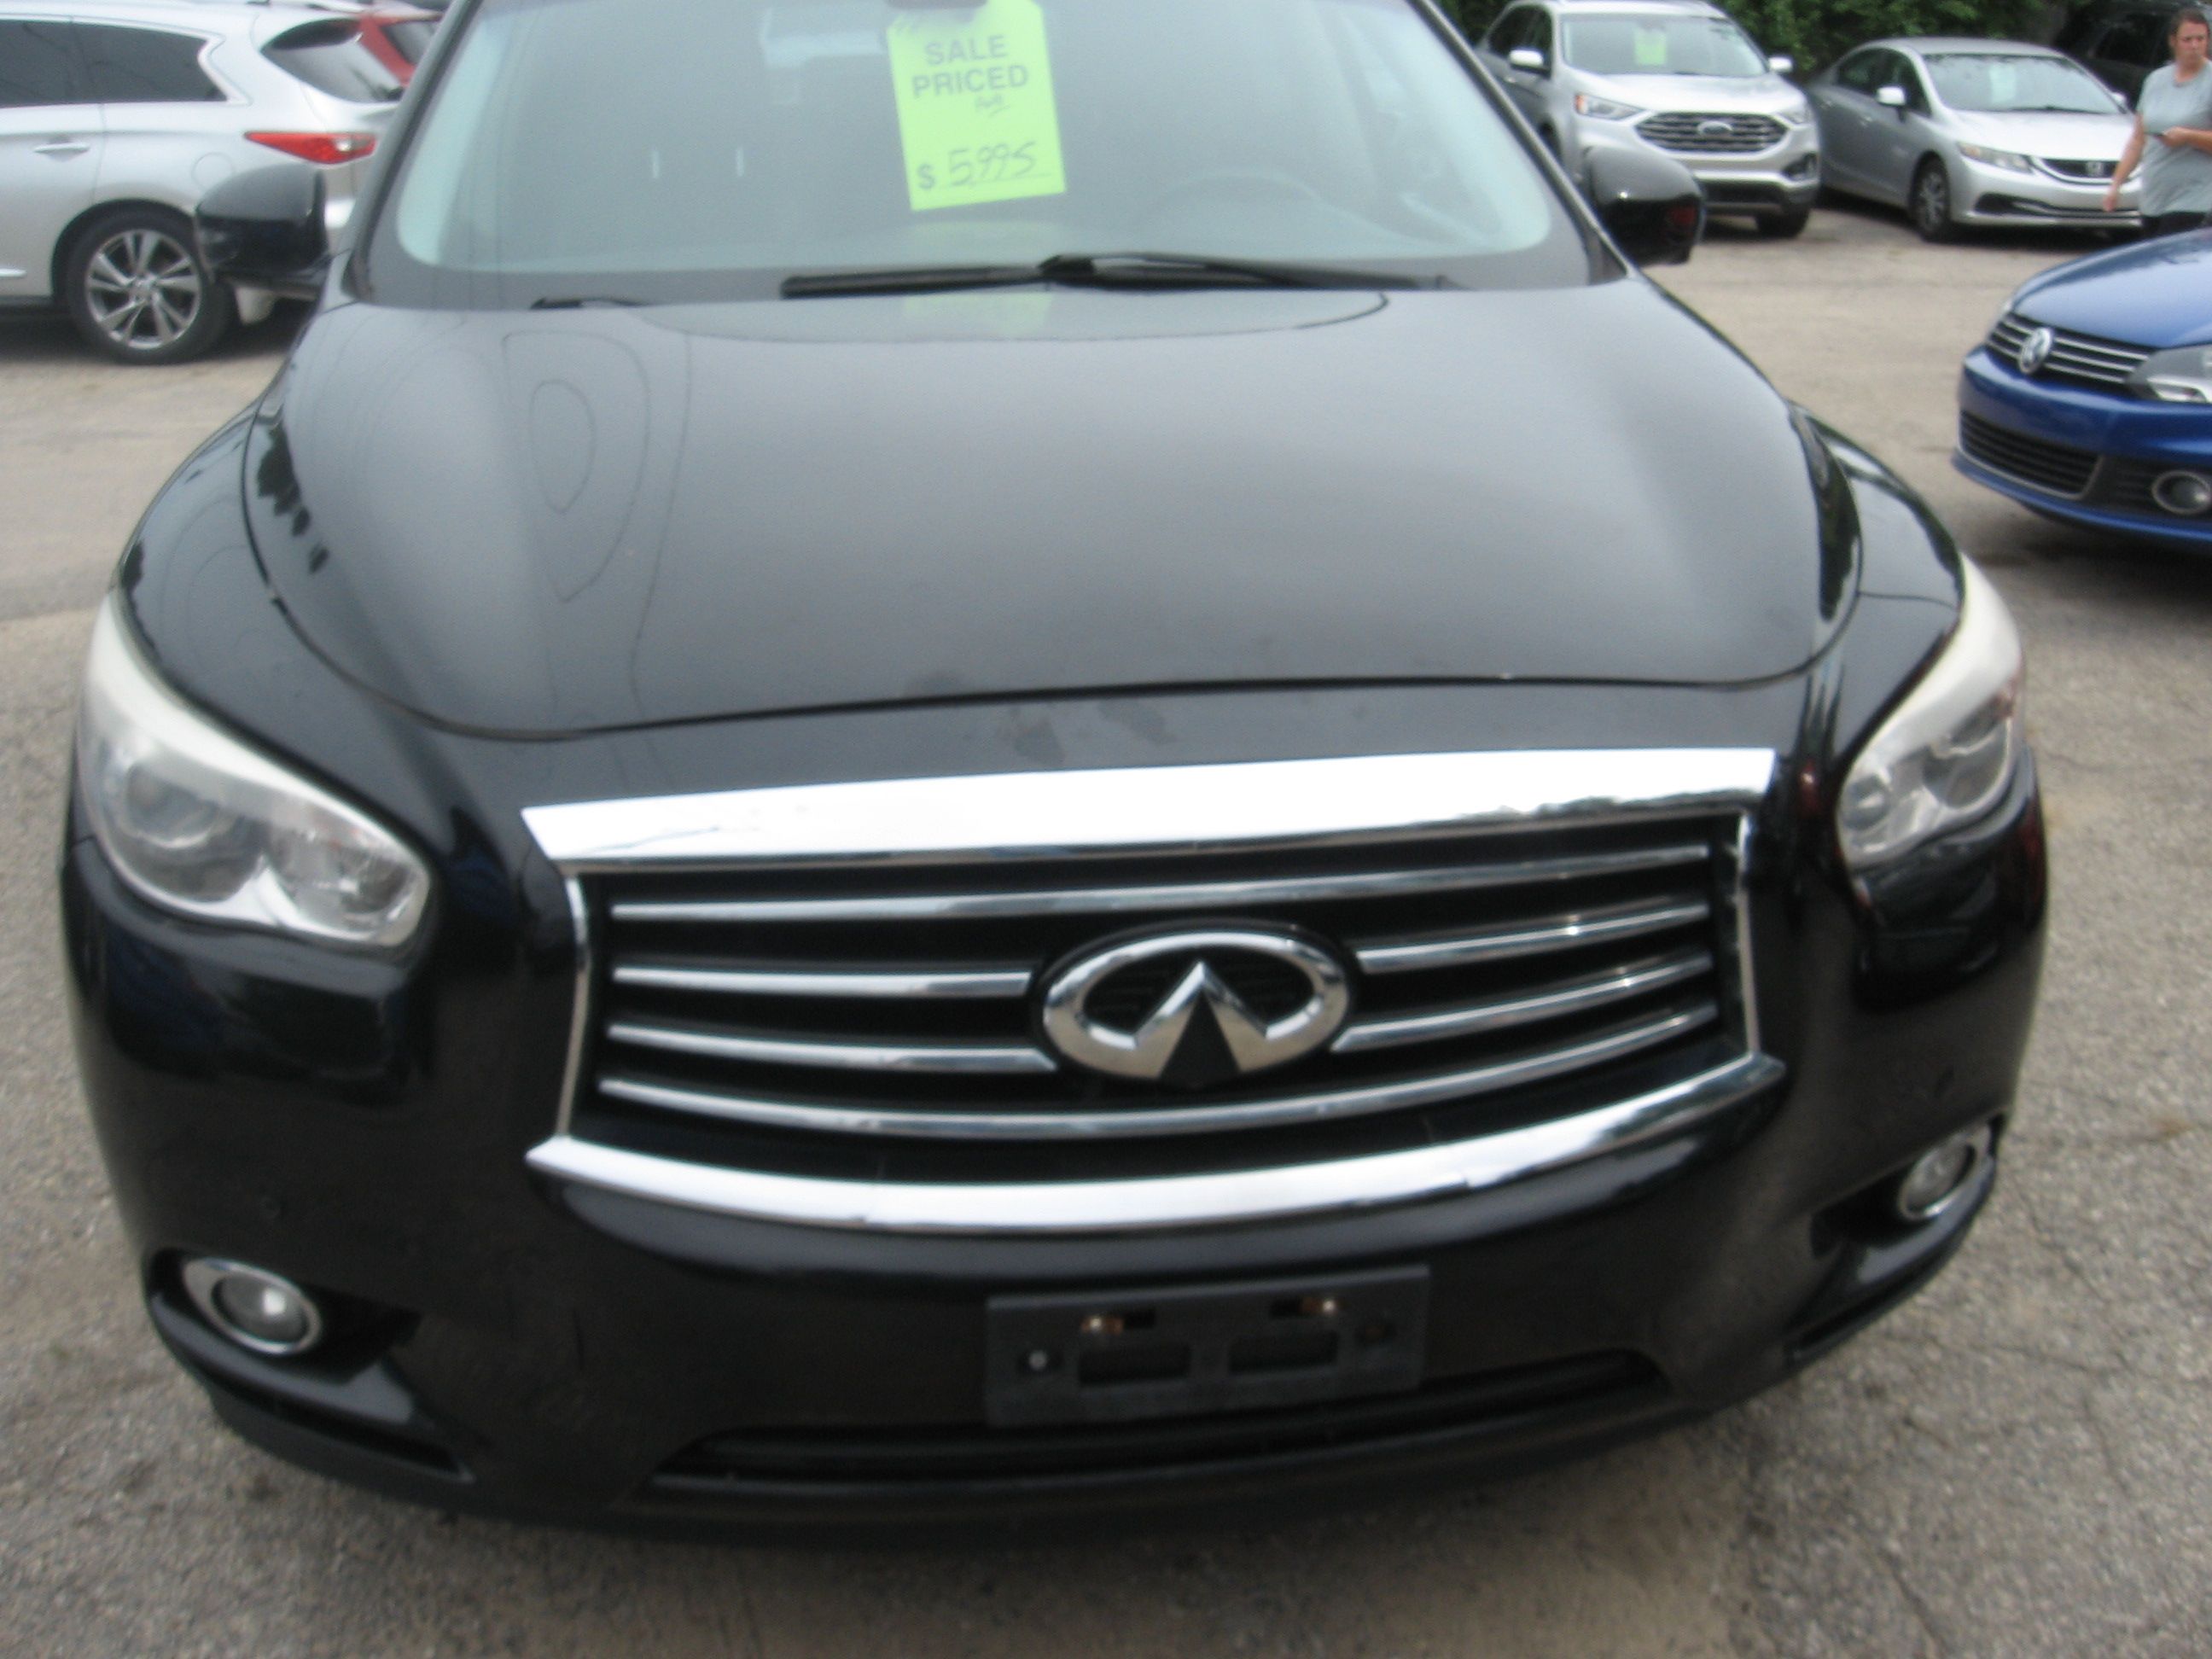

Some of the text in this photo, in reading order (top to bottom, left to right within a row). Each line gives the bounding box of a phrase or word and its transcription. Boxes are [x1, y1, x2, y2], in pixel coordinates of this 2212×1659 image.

[924, 34, 1008, 66] SALE
[911, 64, 1029, 99] PRICED
[948, 141, 1037, 187] 5995
